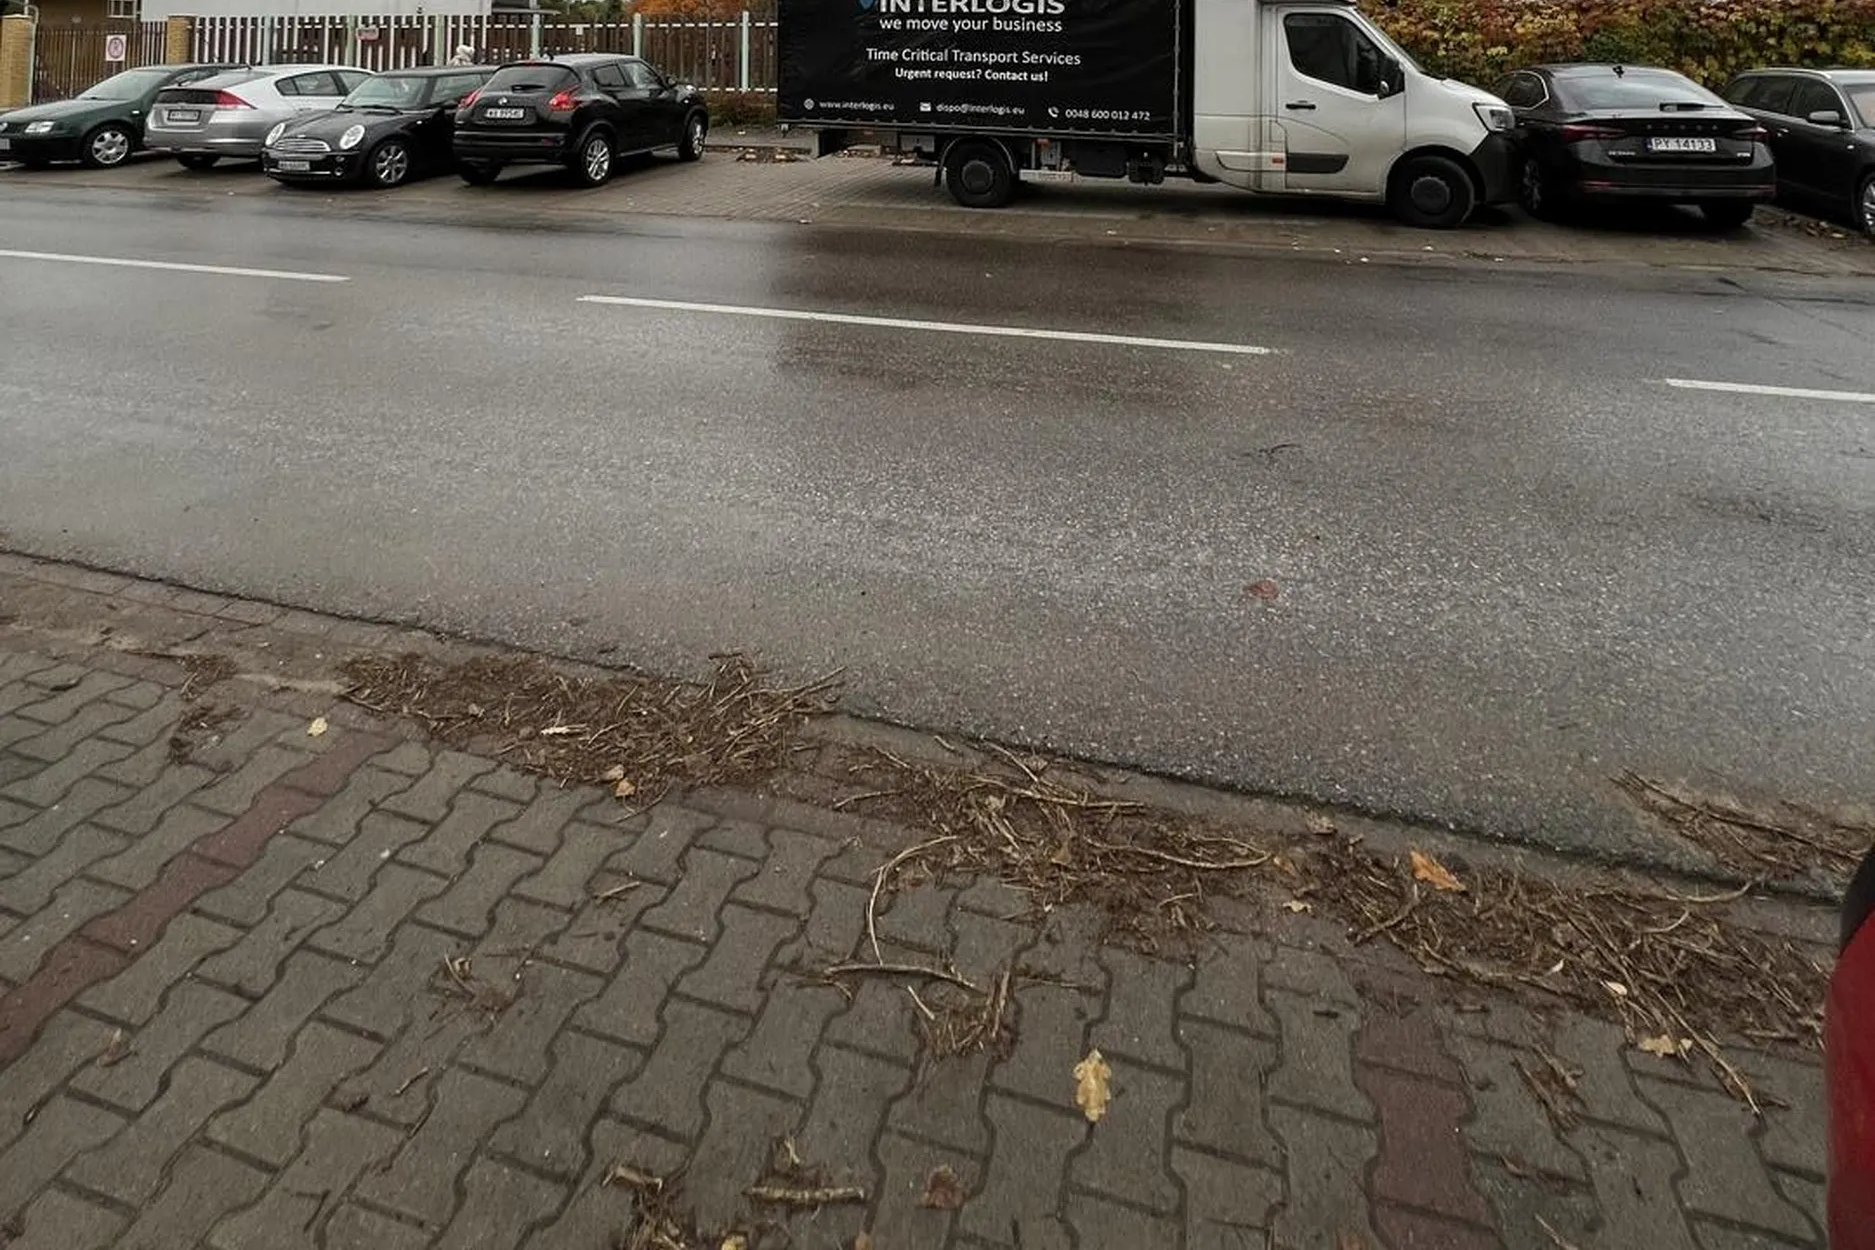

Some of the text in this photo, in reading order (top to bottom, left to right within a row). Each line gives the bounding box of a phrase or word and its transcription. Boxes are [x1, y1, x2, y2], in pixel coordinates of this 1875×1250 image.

[879, 16, 1063, 34] we move your business
[865, 47, 1082, 66] Time Critical Transport Services
[894, 67, 1049, 83] Urgent request? Contact us!
[819, 101, 895, 112] www.interlogis.eu
[935, 102, 1026, 116] dispo@interlogis.eu
[1064, 107, 1151, 121] 0048 600 012 472
